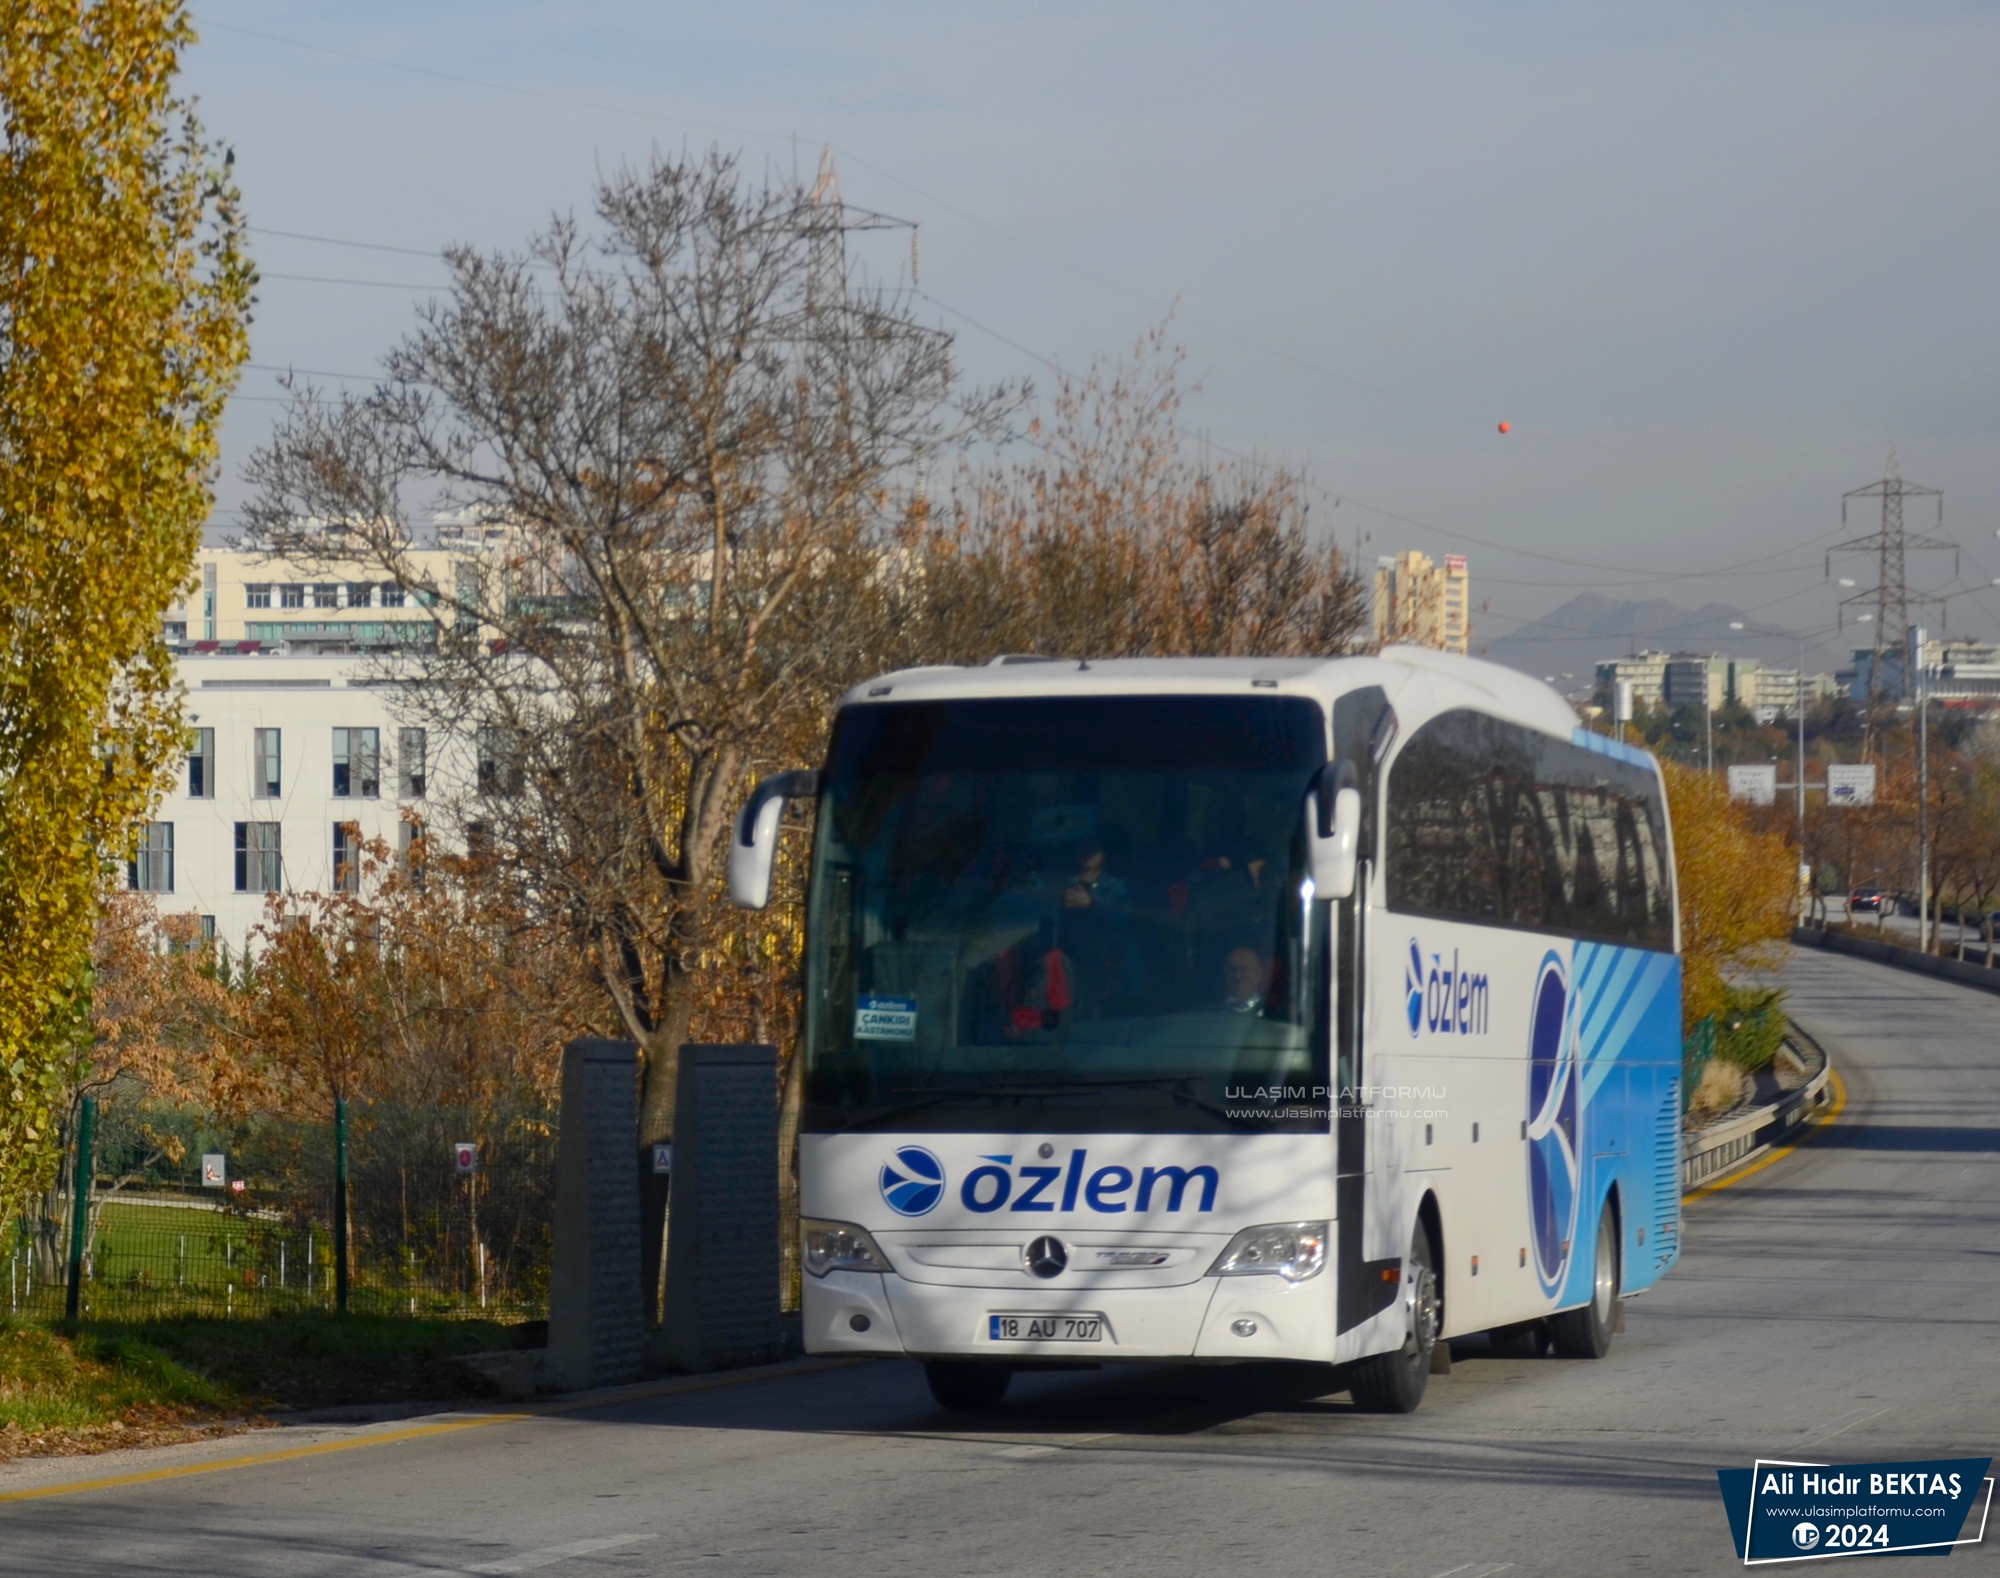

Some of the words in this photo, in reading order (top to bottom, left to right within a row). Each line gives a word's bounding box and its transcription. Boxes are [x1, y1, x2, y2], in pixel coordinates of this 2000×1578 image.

[1428, 948, 1488, 1035] özlem
[862, 1013, 911, 1027] ÇANKIRI
[960, 1148, 1219, 1214] özlem
[1001, 1318, 1018, 1337] 18
[1027, 1319, 1056, 1338] AU
[1065, 1319, 1099, 1338] 707
